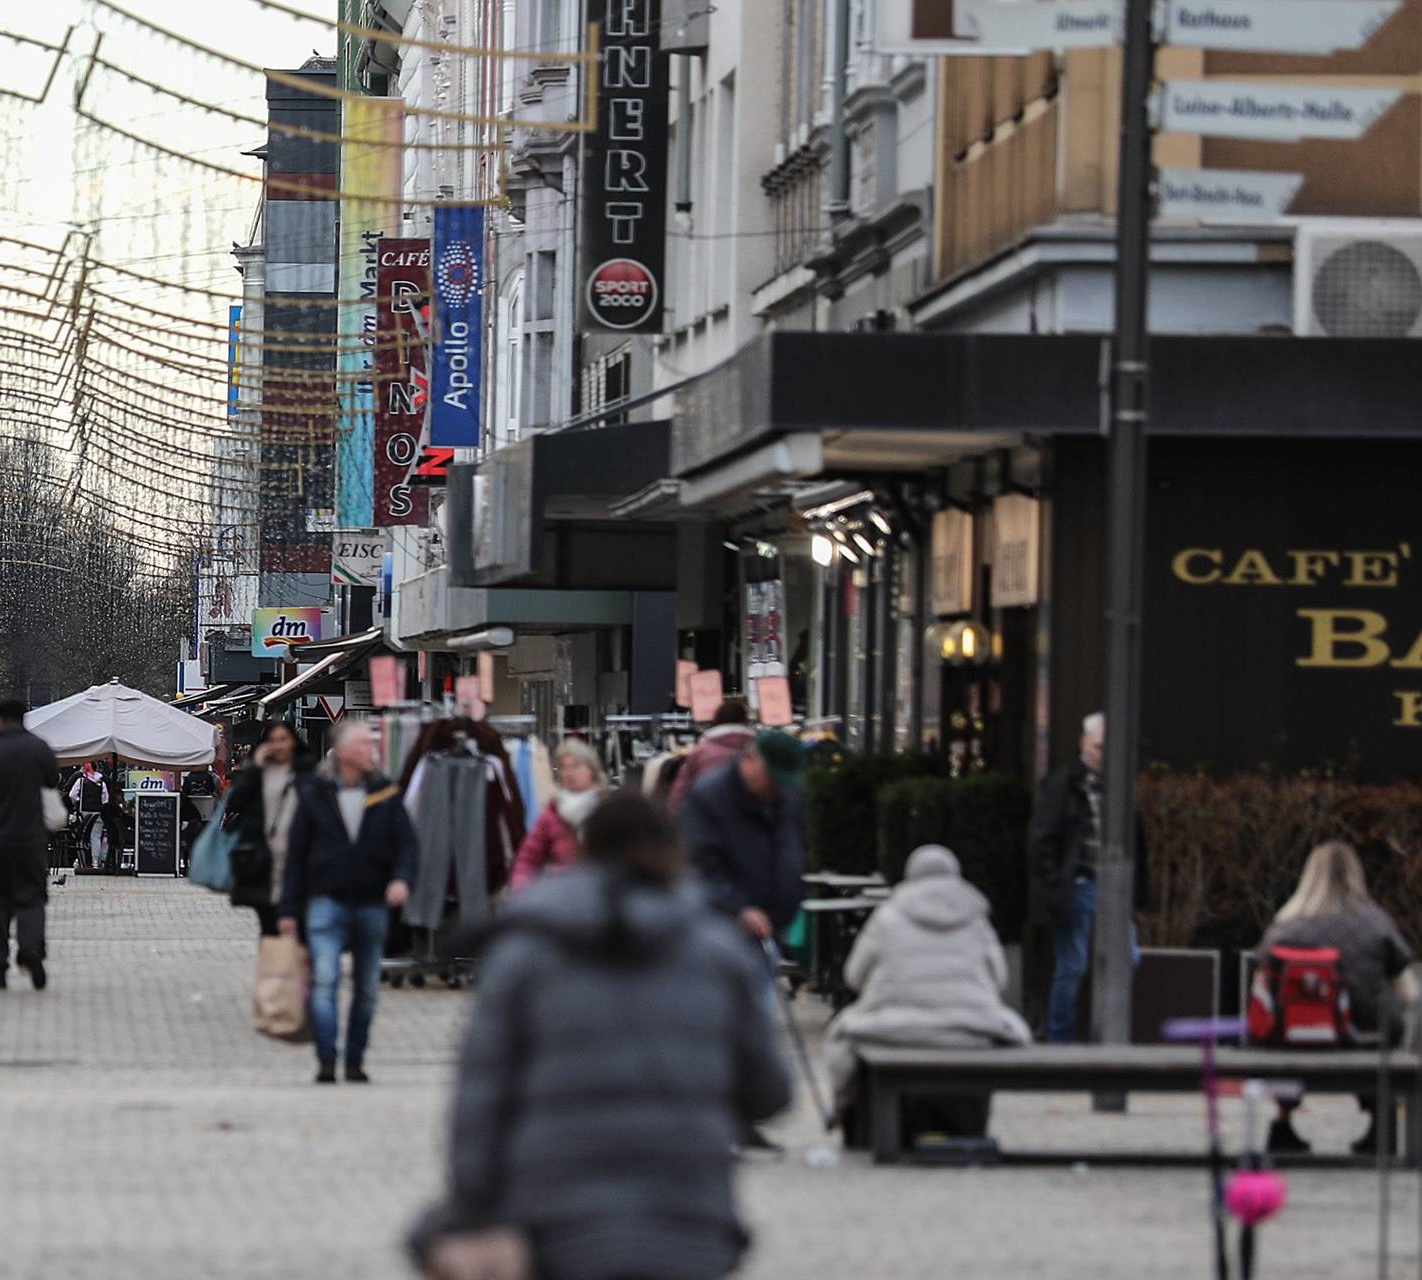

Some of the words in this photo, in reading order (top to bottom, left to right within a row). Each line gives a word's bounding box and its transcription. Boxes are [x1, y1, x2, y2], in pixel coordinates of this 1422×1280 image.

[360, 230, 384, 300] Markt
[381, 249, 430, 267] CAFÉ
[594, 280, 649, 294] SPORT
[599, 293, 644, 307] 2000
[444, 321, 469, 410] Apollo
[272, 616, 307, 637] dm
[140, 776, 164, 789] dm
